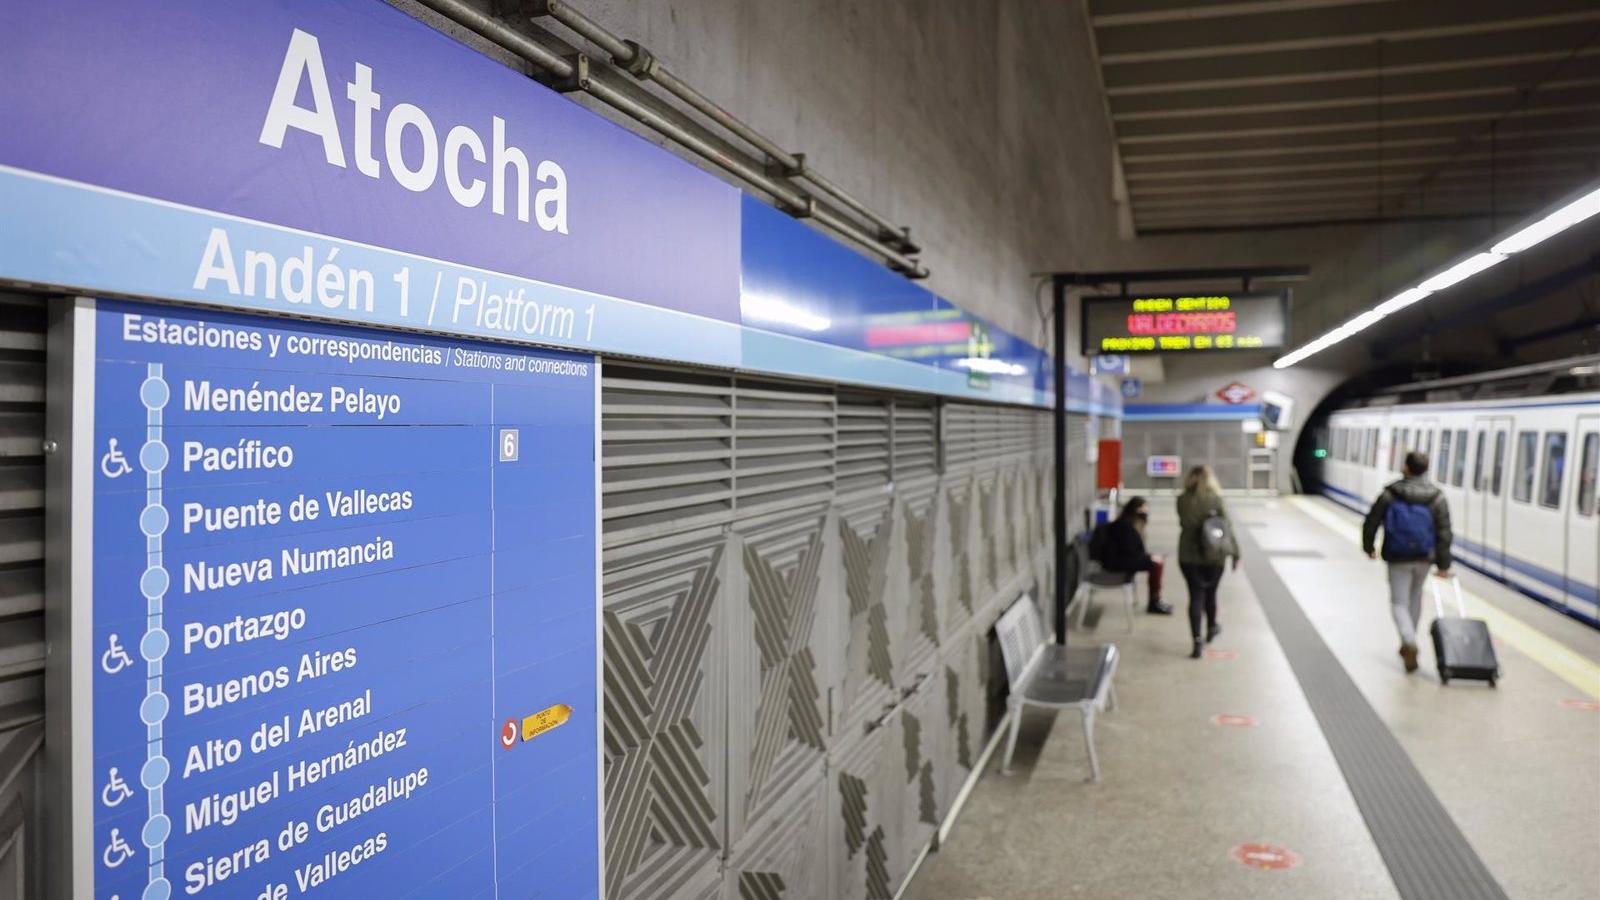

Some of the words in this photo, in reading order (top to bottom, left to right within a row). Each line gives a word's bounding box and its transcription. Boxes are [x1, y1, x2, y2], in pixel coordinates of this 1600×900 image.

[259, 28, 569, 235] Atocha
[193, 227, 375, 313] Andén
[392, 266, 411, 317] 1
[428, 271, 442, 326] /
[452, 276, 575, 339] Platform
[585, 303, 596, 341] 1
[123, 313, 263, 352] Estaciones
[269, 333, 281, 358] y
[286, 335, 442, 366] correspondencias
[445, 347, 451, 368] /
[453, 347, 502, 370] Stations
[504, 355, 527, 372] and
[528, 359, 589, 377] connections
[184, 380, 323, 412] Menéndez
[330, 386, 401, 420] Pelayo
[183, 439, 294, 472] Pacífico
[504, 433, 515, 457] 6
[183, 498, 282, 534] Puente
[289, 494, 320, 522] de
[325, 489, 413, 517] Vallecas
[184, 557, 273, 594] Nueva
[281, 536, 394, 577] Numancia
[184, 608, 306, 654] Portazgo
[184, 666, 290, 716] Buenos
[296, 645, 357, 683] Aires
[183, 739, 242, 779] Alto
[250, 722, 290, 754] del
[297, 689, 371, 738] Arenal
[185, 782, 280, 834] Miguel
[288, 728, 407, 792] Hernández
[185, 839, 270, 894] Sierra
[278, 821, 309, 852] de
[316, 766, 428, 833] Guadalupe
[257, 883, 288, 900] de
[294, 832, 388, 893] Vallecas
